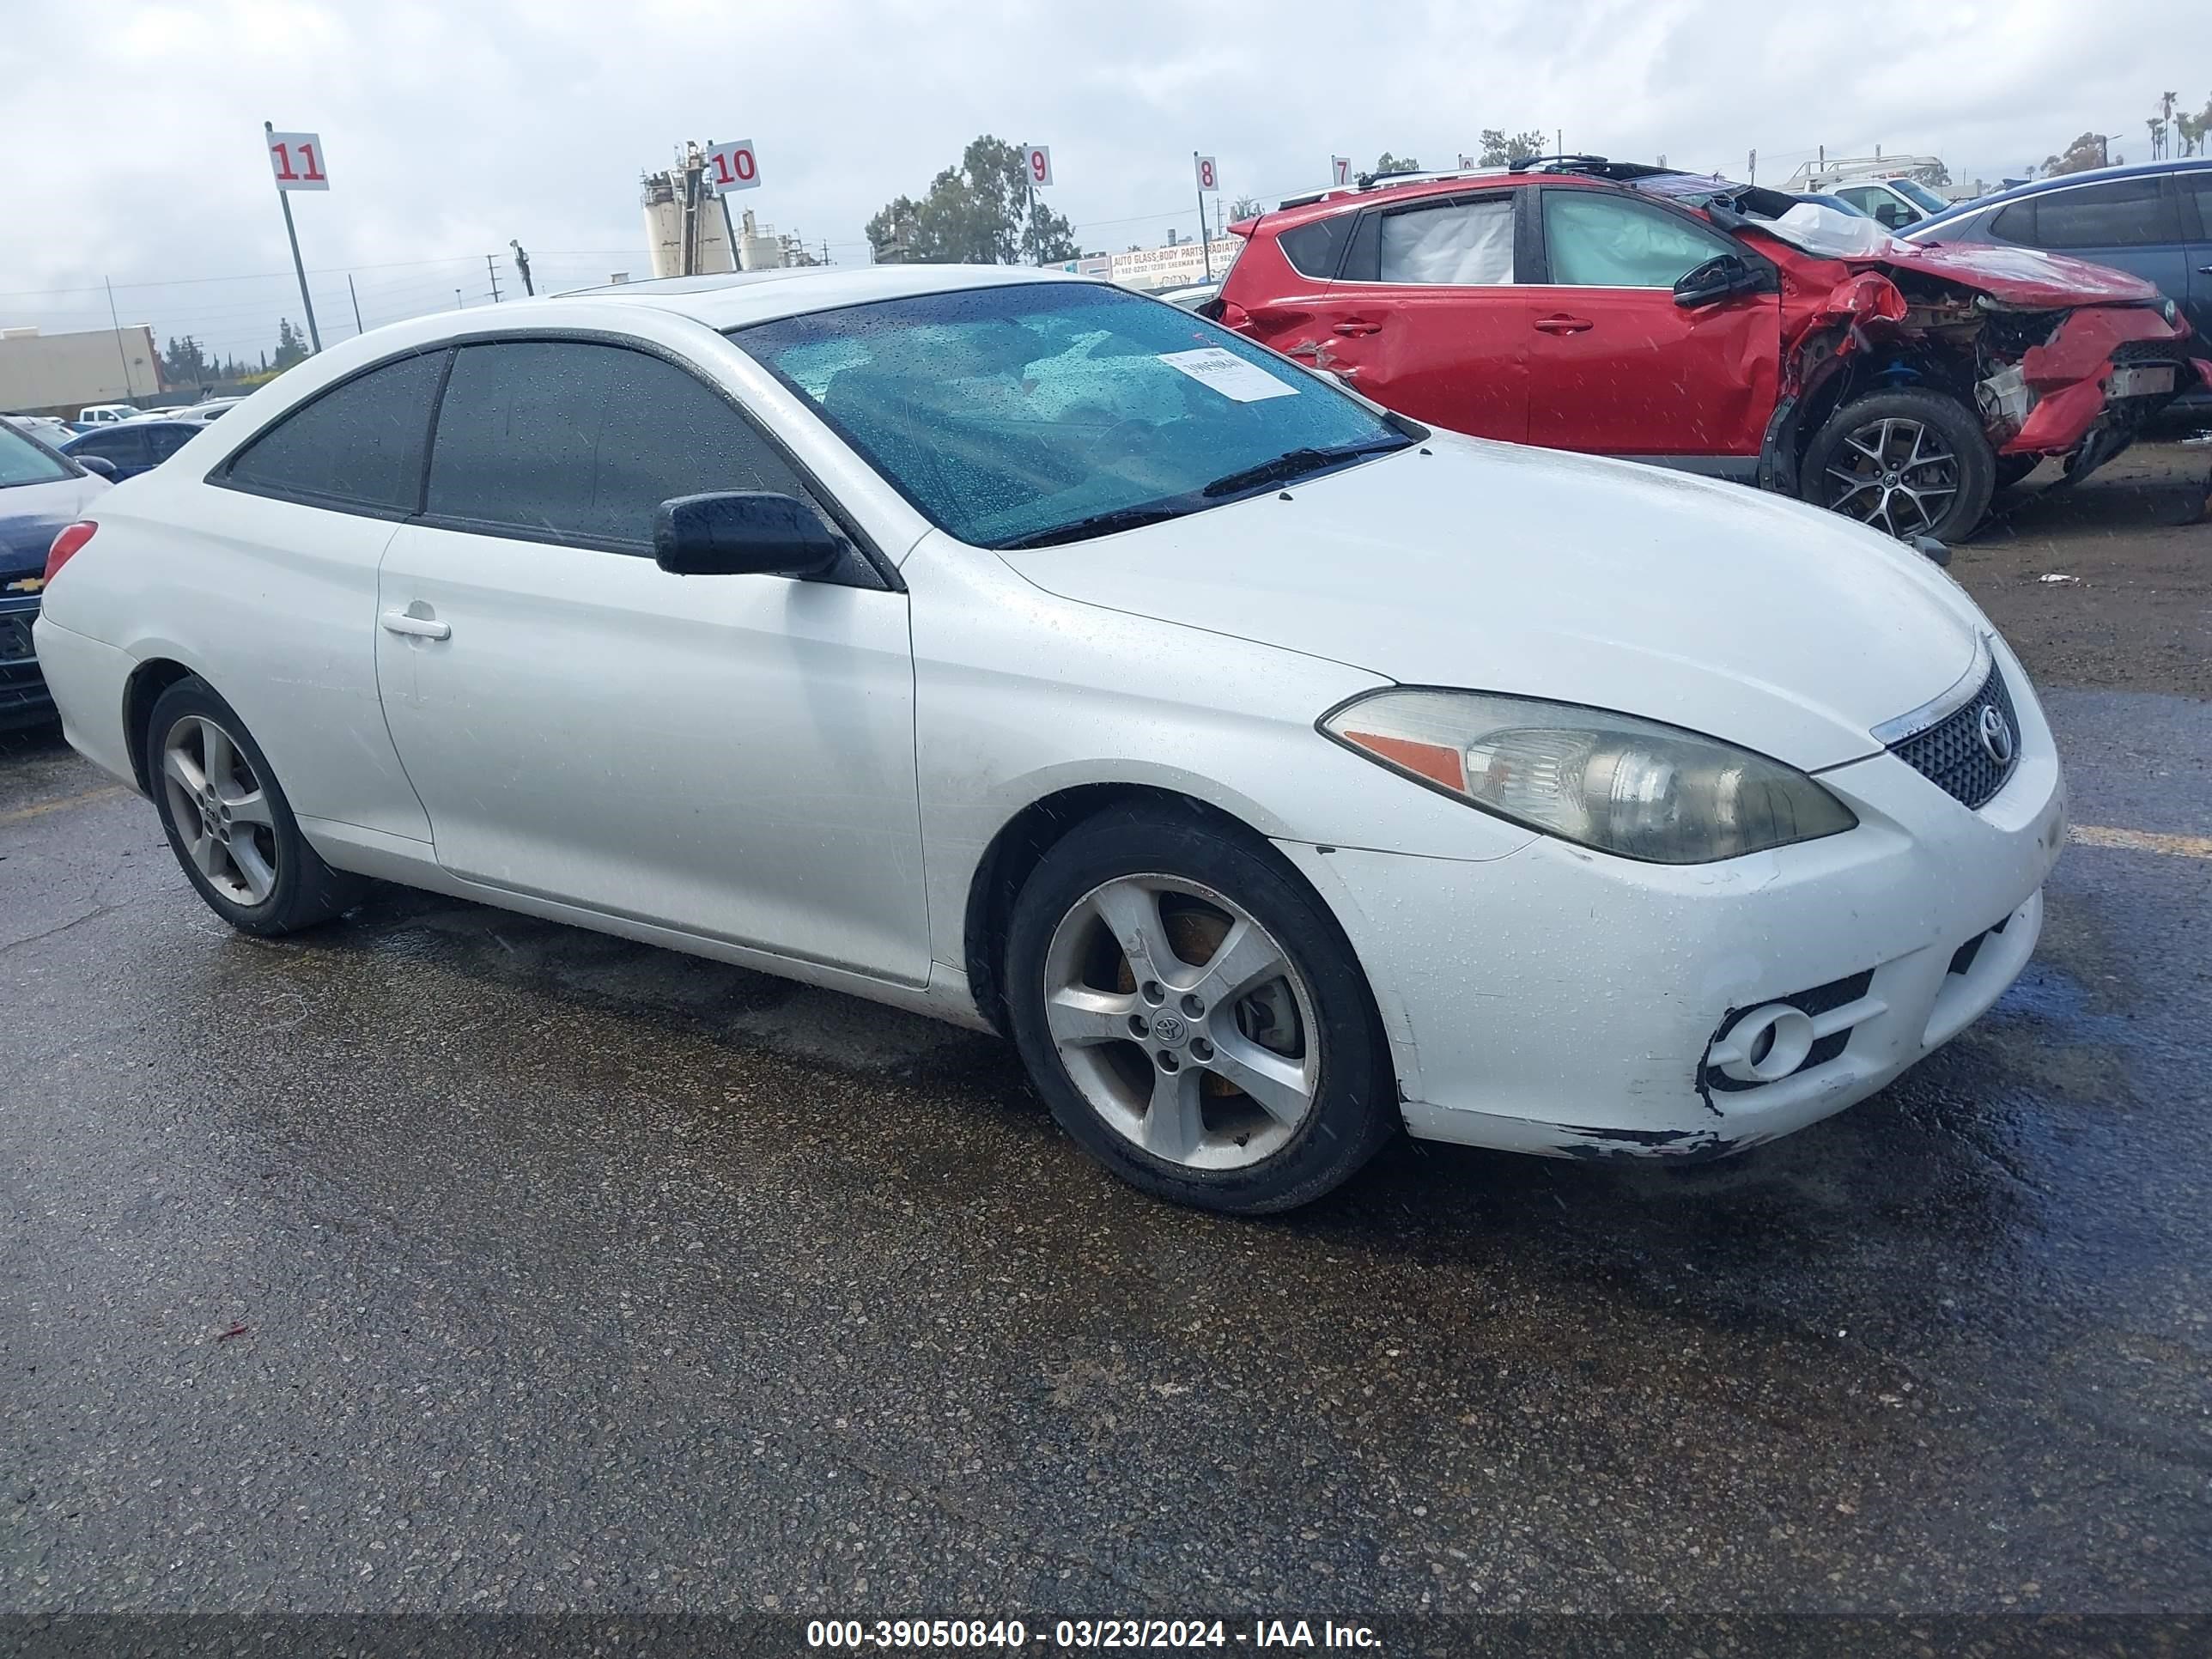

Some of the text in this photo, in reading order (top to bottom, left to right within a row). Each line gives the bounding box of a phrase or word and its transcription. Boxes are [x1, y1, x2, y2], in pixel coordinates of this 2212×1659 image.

[271, 143, 325, 180] 11
[711, 149, 755, 185] 10
[1031, 150, 1046, 181] 9
[1201, 161, 1213, 187] 8
[1337, 161, 1347, 185] 7
[1114, 255, 1132, 266] AUTO
[1159, 248, 1178, 261] BODY
[1181, 246, 1204, 258] PARTS
[1182, 358, 1244, 374] 39050840
